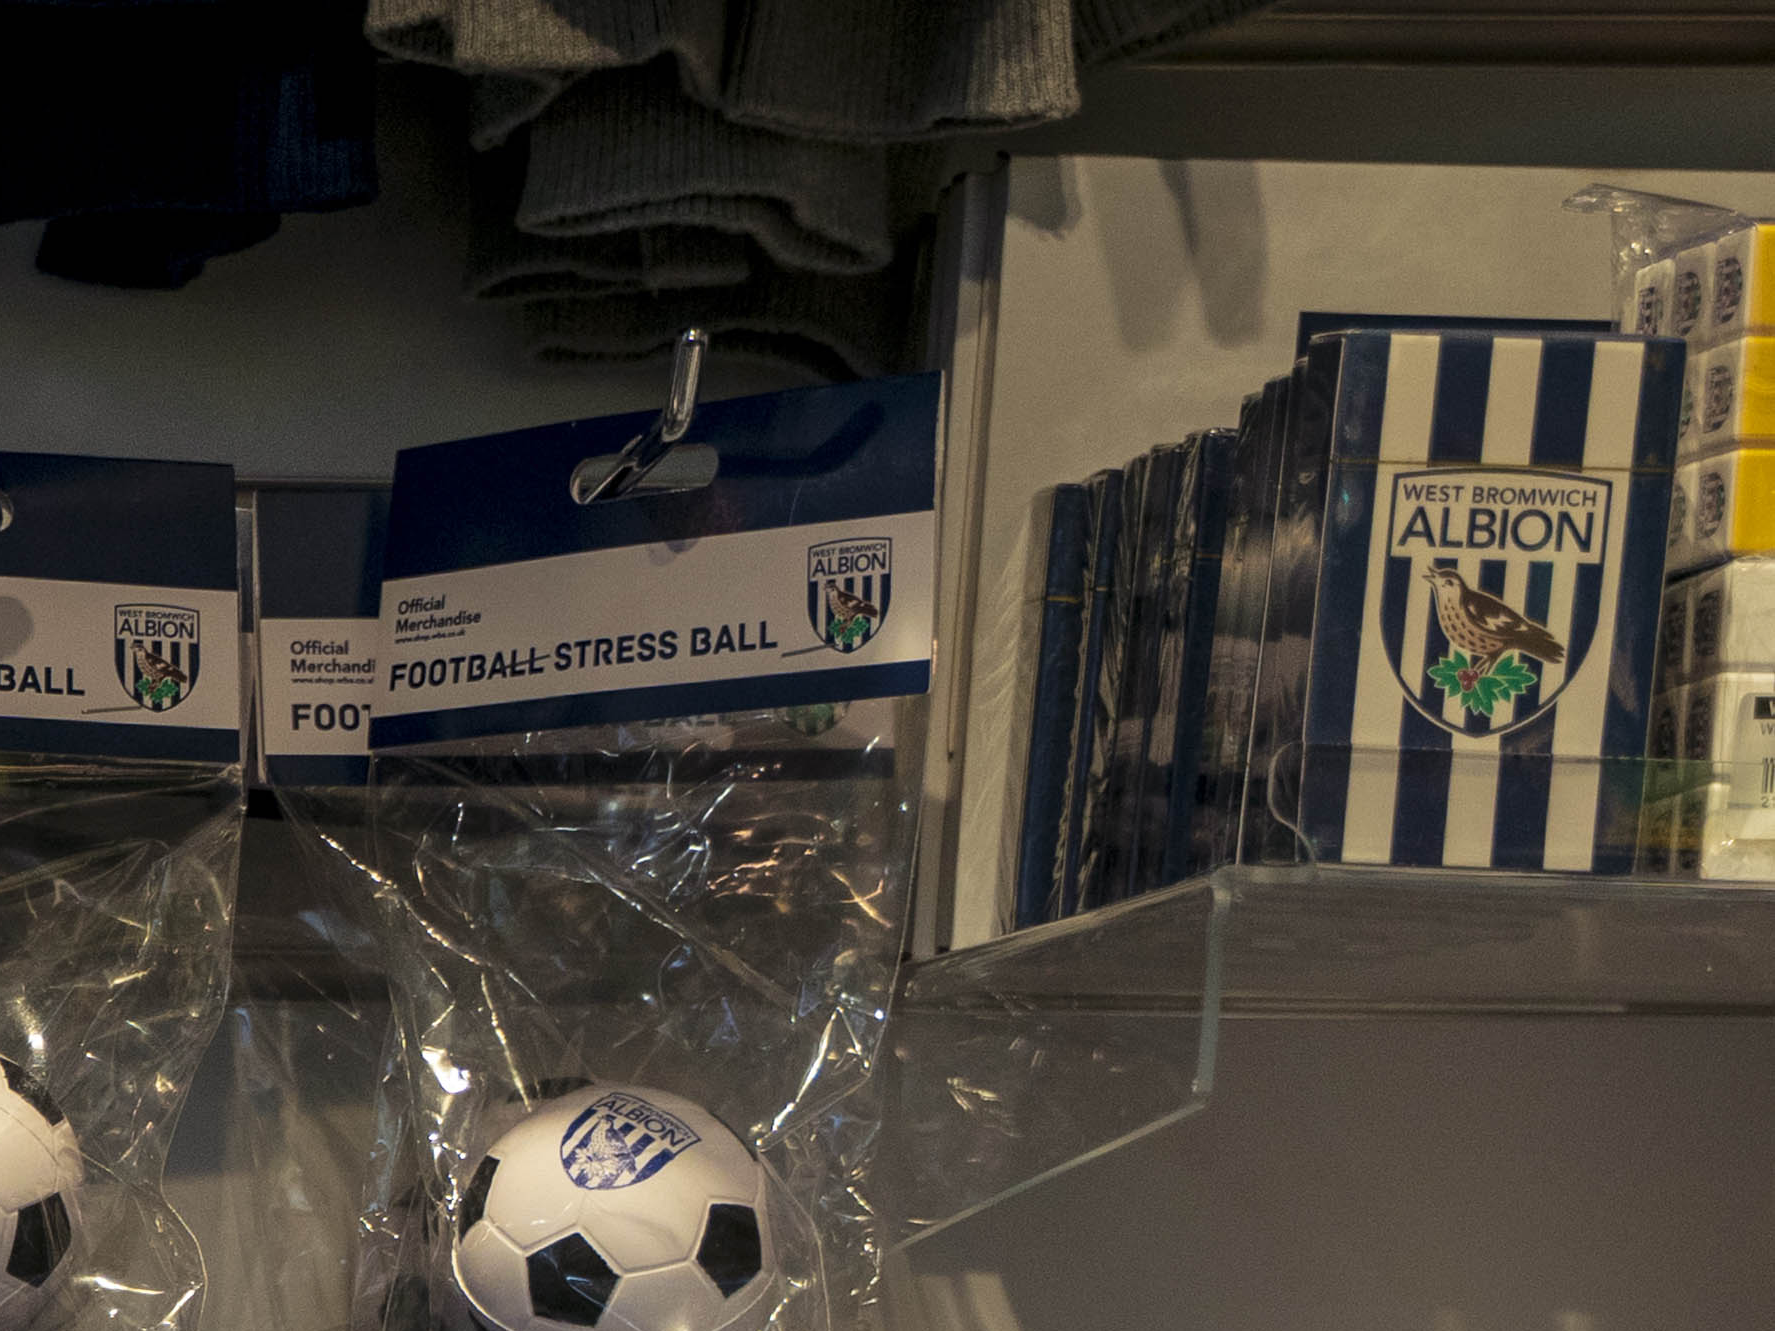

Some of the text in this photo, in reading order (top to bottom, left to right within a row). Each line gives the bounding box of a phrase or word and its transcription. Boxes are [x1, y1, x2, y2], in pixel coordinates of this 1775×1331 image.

[1402, 483, 1598, 507] WEST BROMWICH
[1397, 507, 1596, 553] ALBION
[811, 552, 889, 577] ALBION
[398, 595, 446, 614] Official
[118, 617, 195, 640] ALBION
[395, 610, 481, 634] Merchandise
[389, 652, 549, 691] FOOTBALL
[553, 627, 678, 670] STRESS
[689, 621, 778, 655] BALL
[597, 1101, 688, 1148] ALBION
